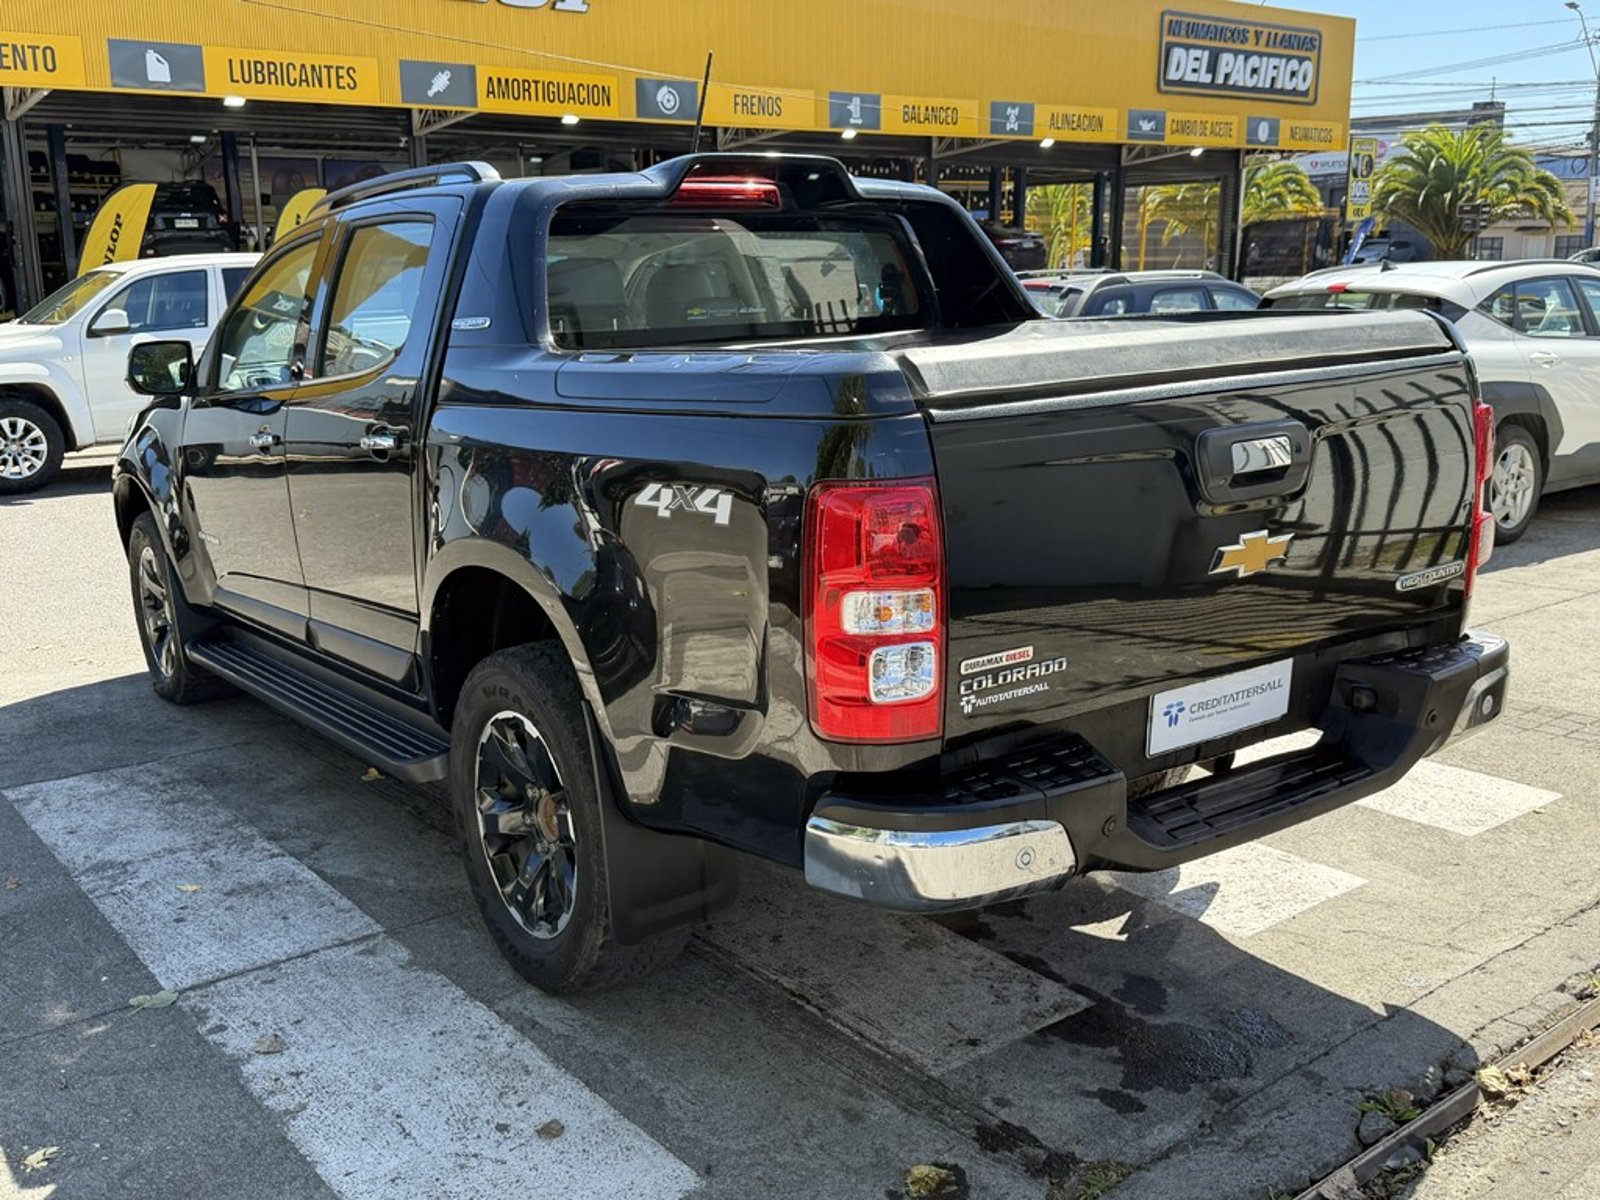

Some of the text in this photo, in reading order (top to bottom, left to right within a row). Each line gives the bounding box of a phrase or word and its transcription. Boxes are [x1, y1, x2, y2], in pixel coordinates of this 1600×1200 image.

[1168, 19, 1317, 52] NEUMATICOS Y LLANTAS
[228, 58, 358, 91] LUBRICANTES
[1166, 47, 1313, 91] DEL PACIFICO
[486, 76, 611, 107] AMORTIGUACION
[733, 94, 782, 117] FRENOS
[902, 105, 959, 127] BALANCEO
[1050, 112, 1104, 132] ALINEACION
[1170, 118, 1233, 138] CAMBIO DE ACEITE
[1289, 126, 1333, 143] NEUMATICOS
[963, 649, 1031, 672] DURAMAX DIESEL
[960, 657, 1067, 695] COLORADO
[975, 681, 1050, 707] AUTOTATTERSALL
[1189, 678, 1284, 715] CREDITATTERSALL
